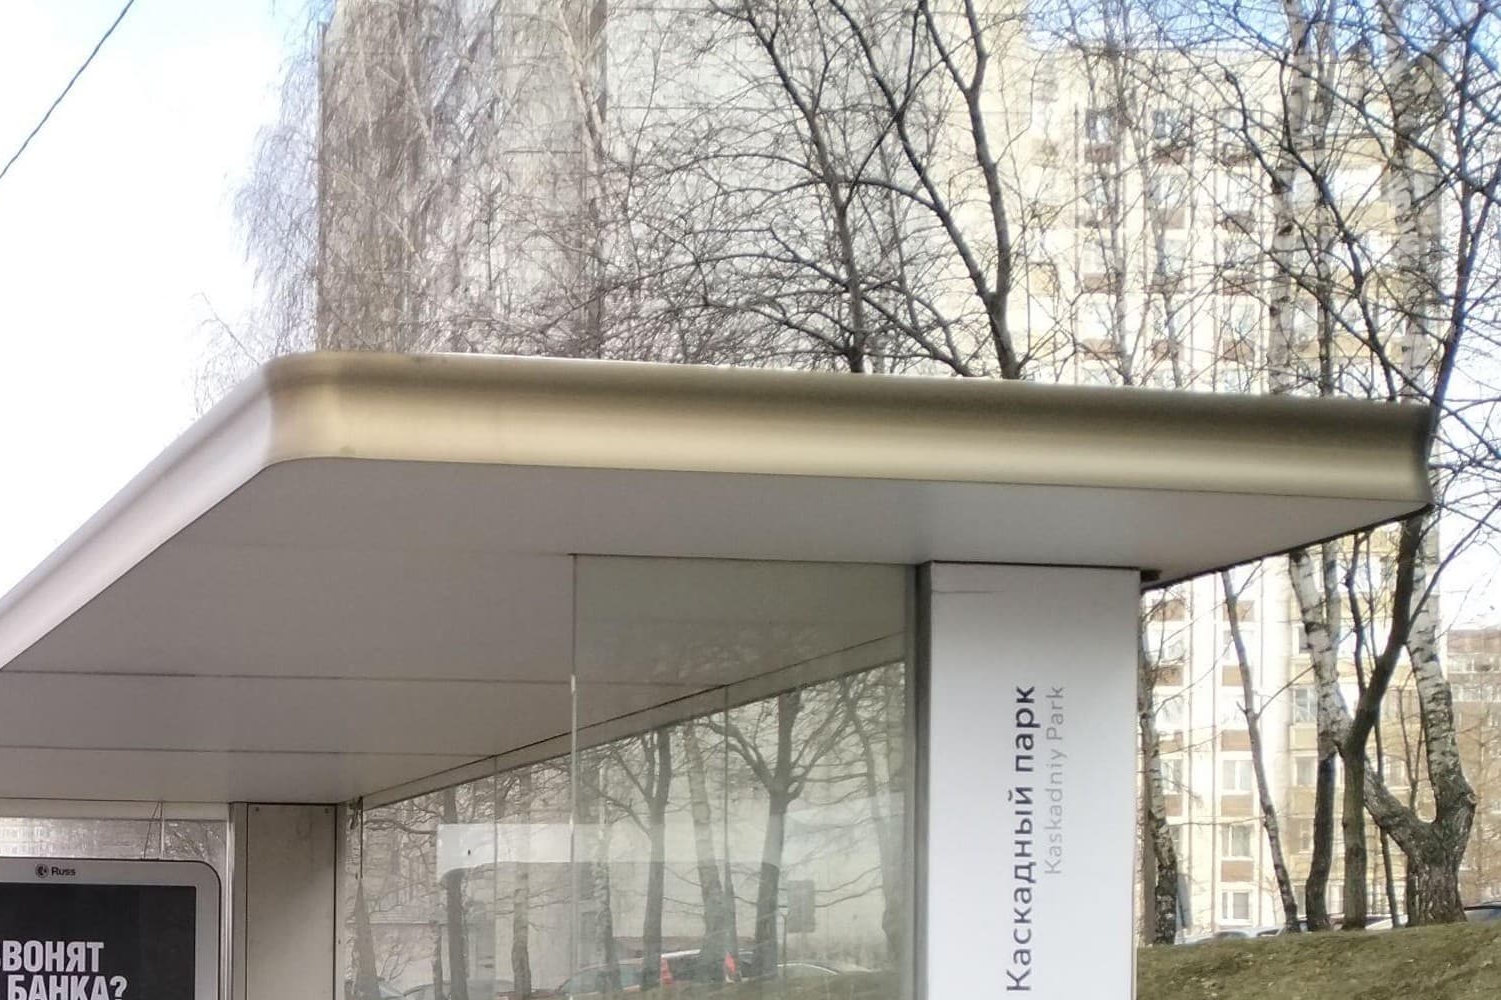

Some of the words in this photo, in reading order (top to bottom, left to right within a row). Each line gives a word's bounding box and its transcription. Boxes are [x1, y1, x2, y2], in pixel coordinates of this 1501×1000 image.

[1014, 685, 1040, 772] парк
[1045, 685, 1065, 741] Park
[1044, 746, 1068, 875] Kaskadniy
[1006, 786, 1037, 992] Каскадный
